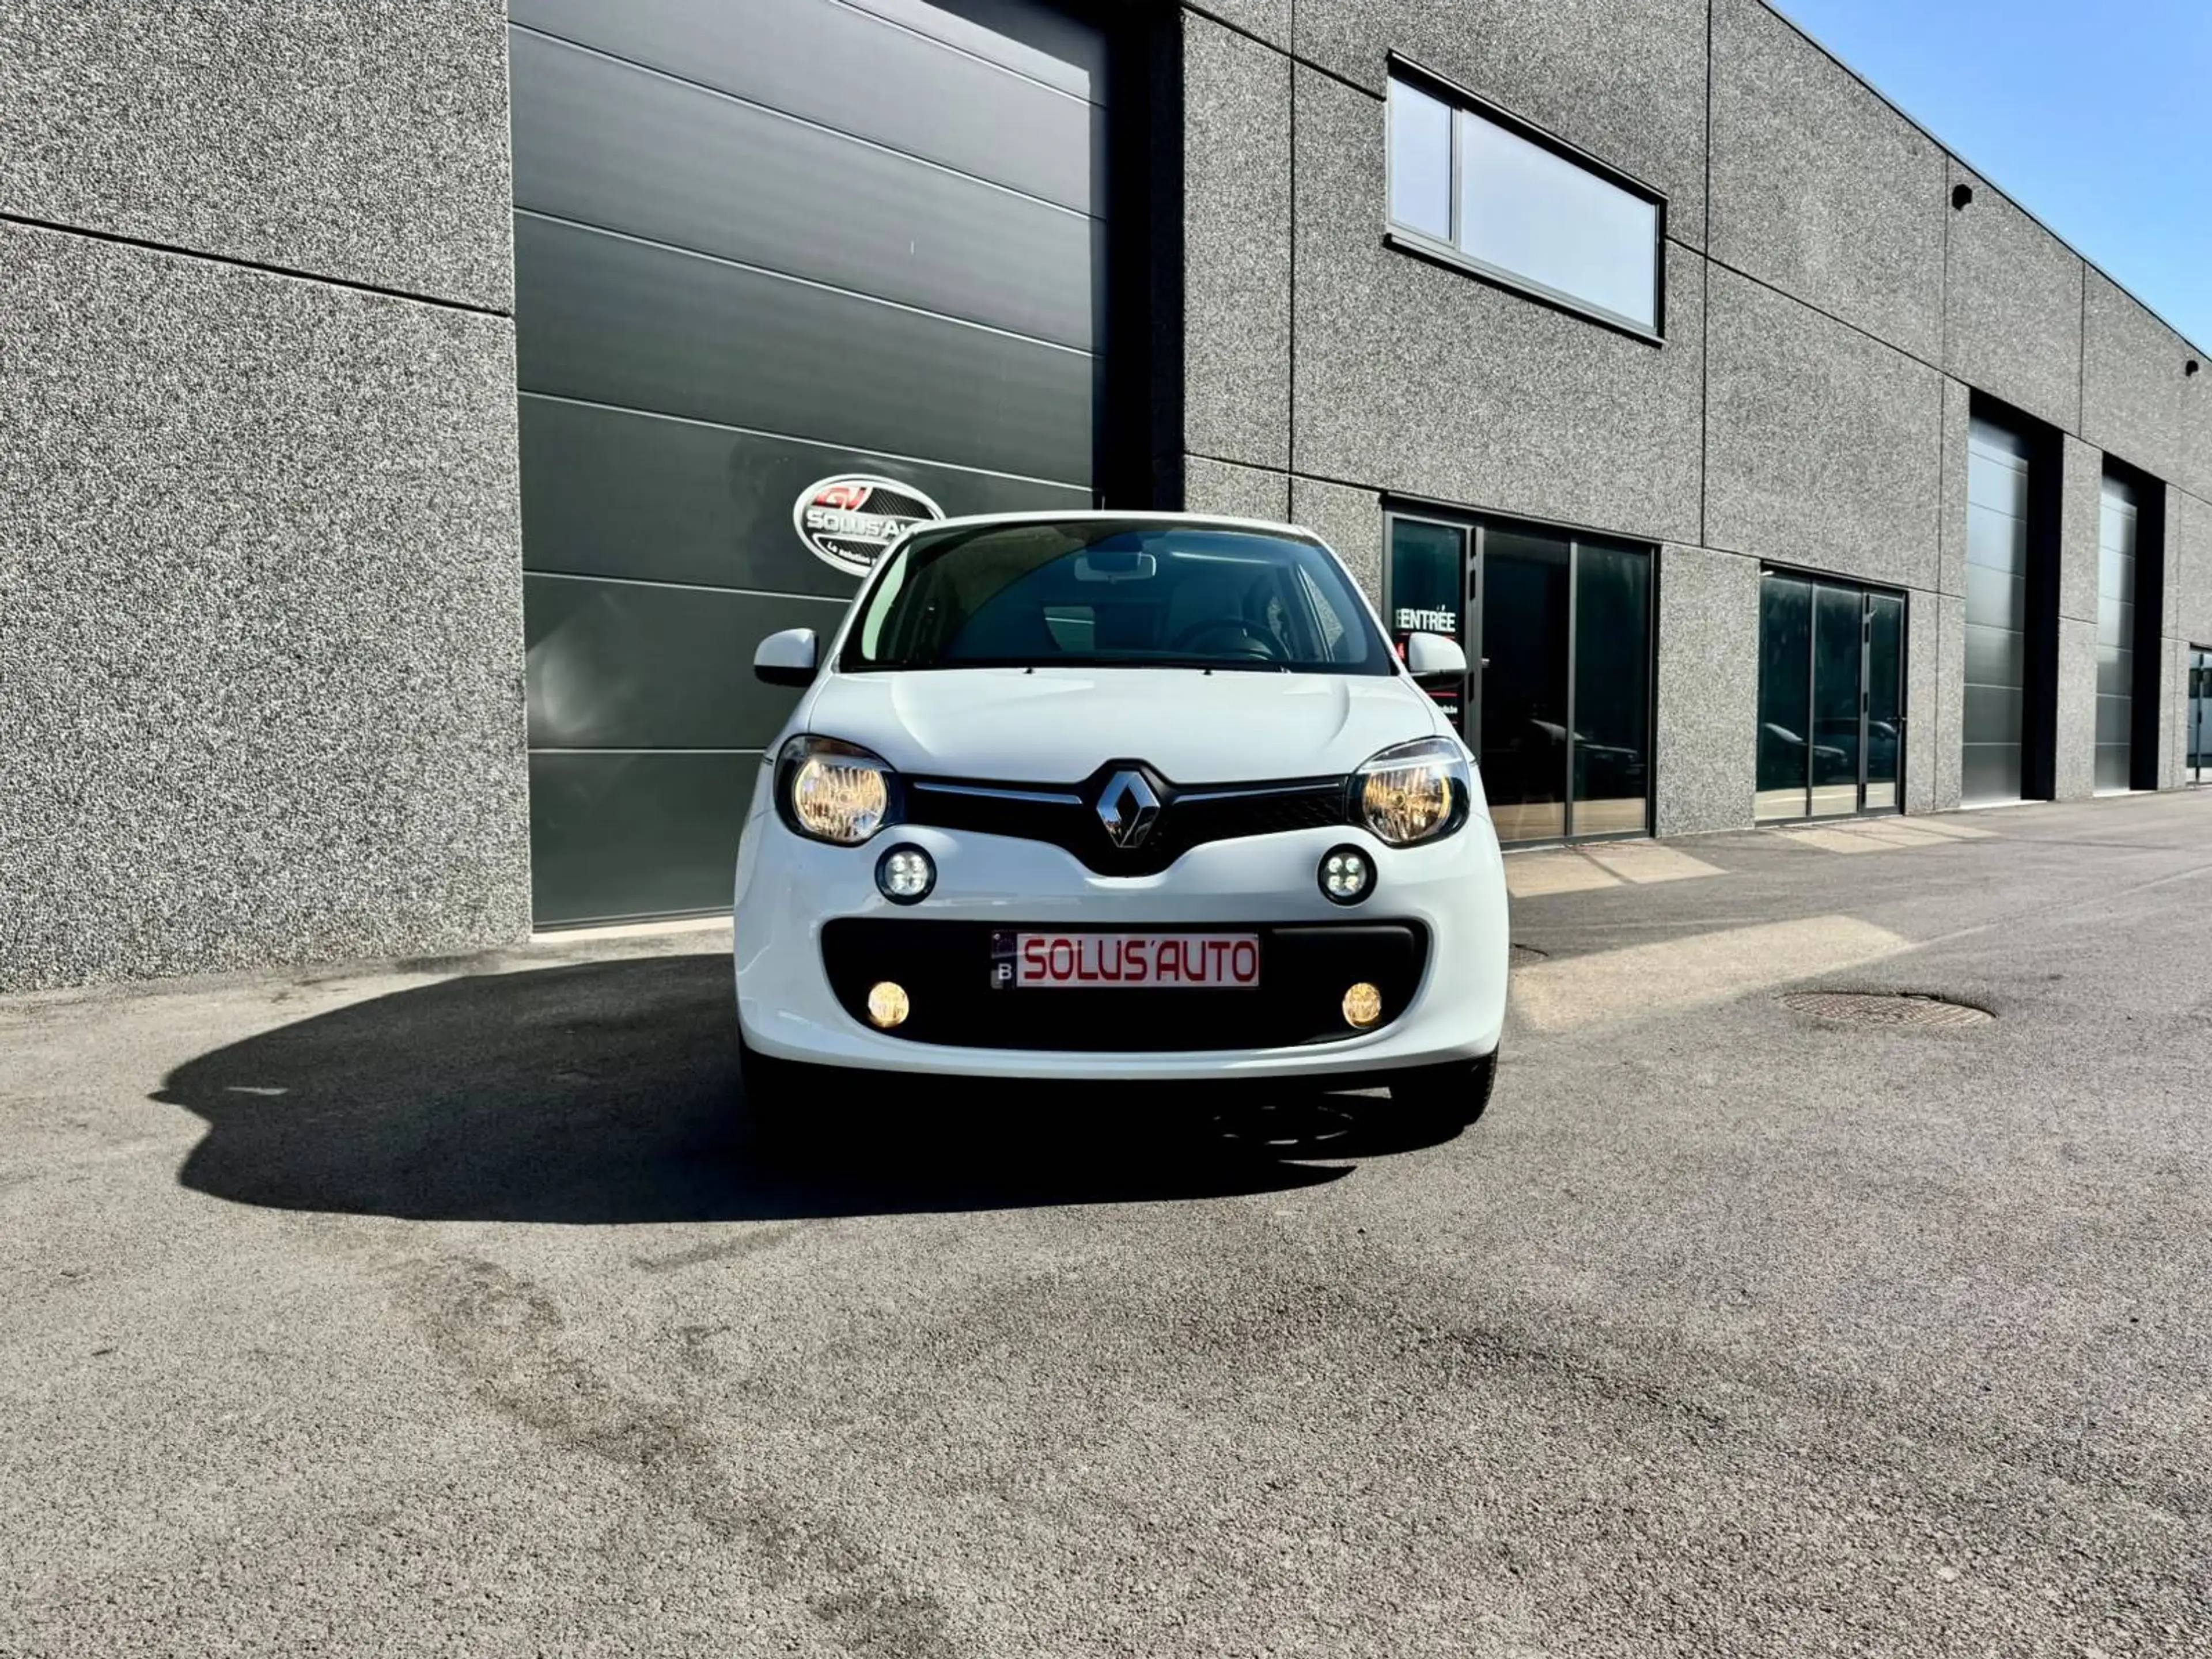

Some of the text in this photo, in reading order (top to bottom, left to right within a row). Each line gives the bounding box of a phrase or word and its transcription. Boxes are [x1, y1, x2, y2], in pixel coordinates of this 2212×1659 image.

[807, 510, 906, 538] SOLUS'A
[1400, 604, 1456, 632] ENTRÉE
[998, 963, 1012, 980] B
